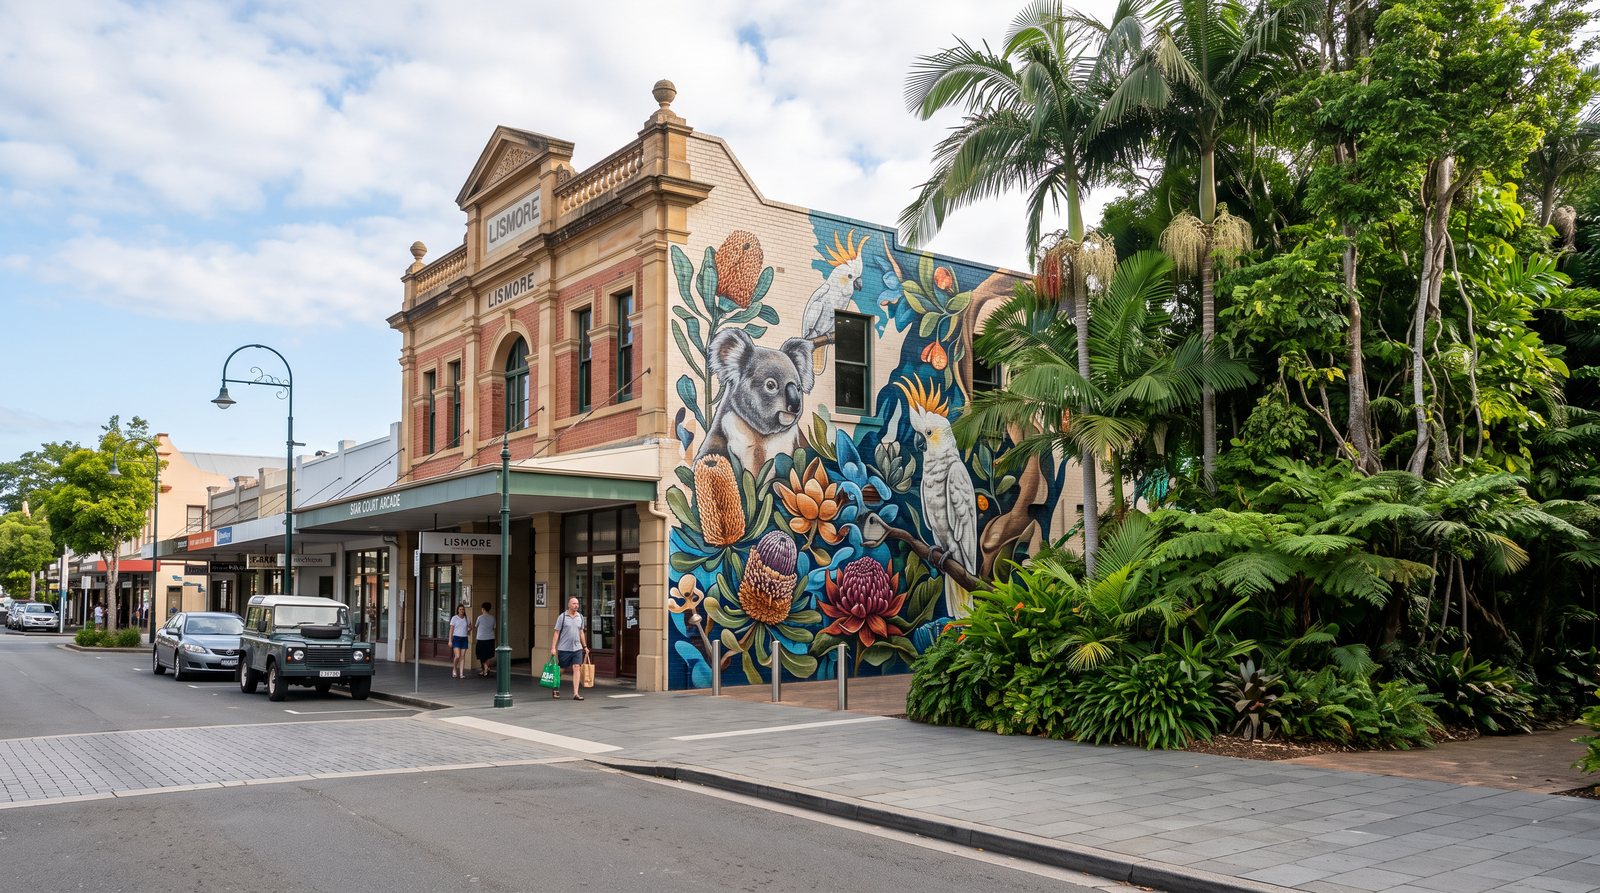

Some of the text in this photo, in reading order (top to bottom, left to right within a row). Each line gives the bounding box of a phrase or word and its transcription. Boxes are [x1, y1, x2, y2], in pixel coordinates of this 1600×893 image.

[489, 196, 540, 243] LISMORE
[488, 272, 535, 308] LISMORE
[362, 498, 379, 512] COURT
[380, 493, 401, 509] ARCADE
[444, 538, 492, 548] LISMORE
